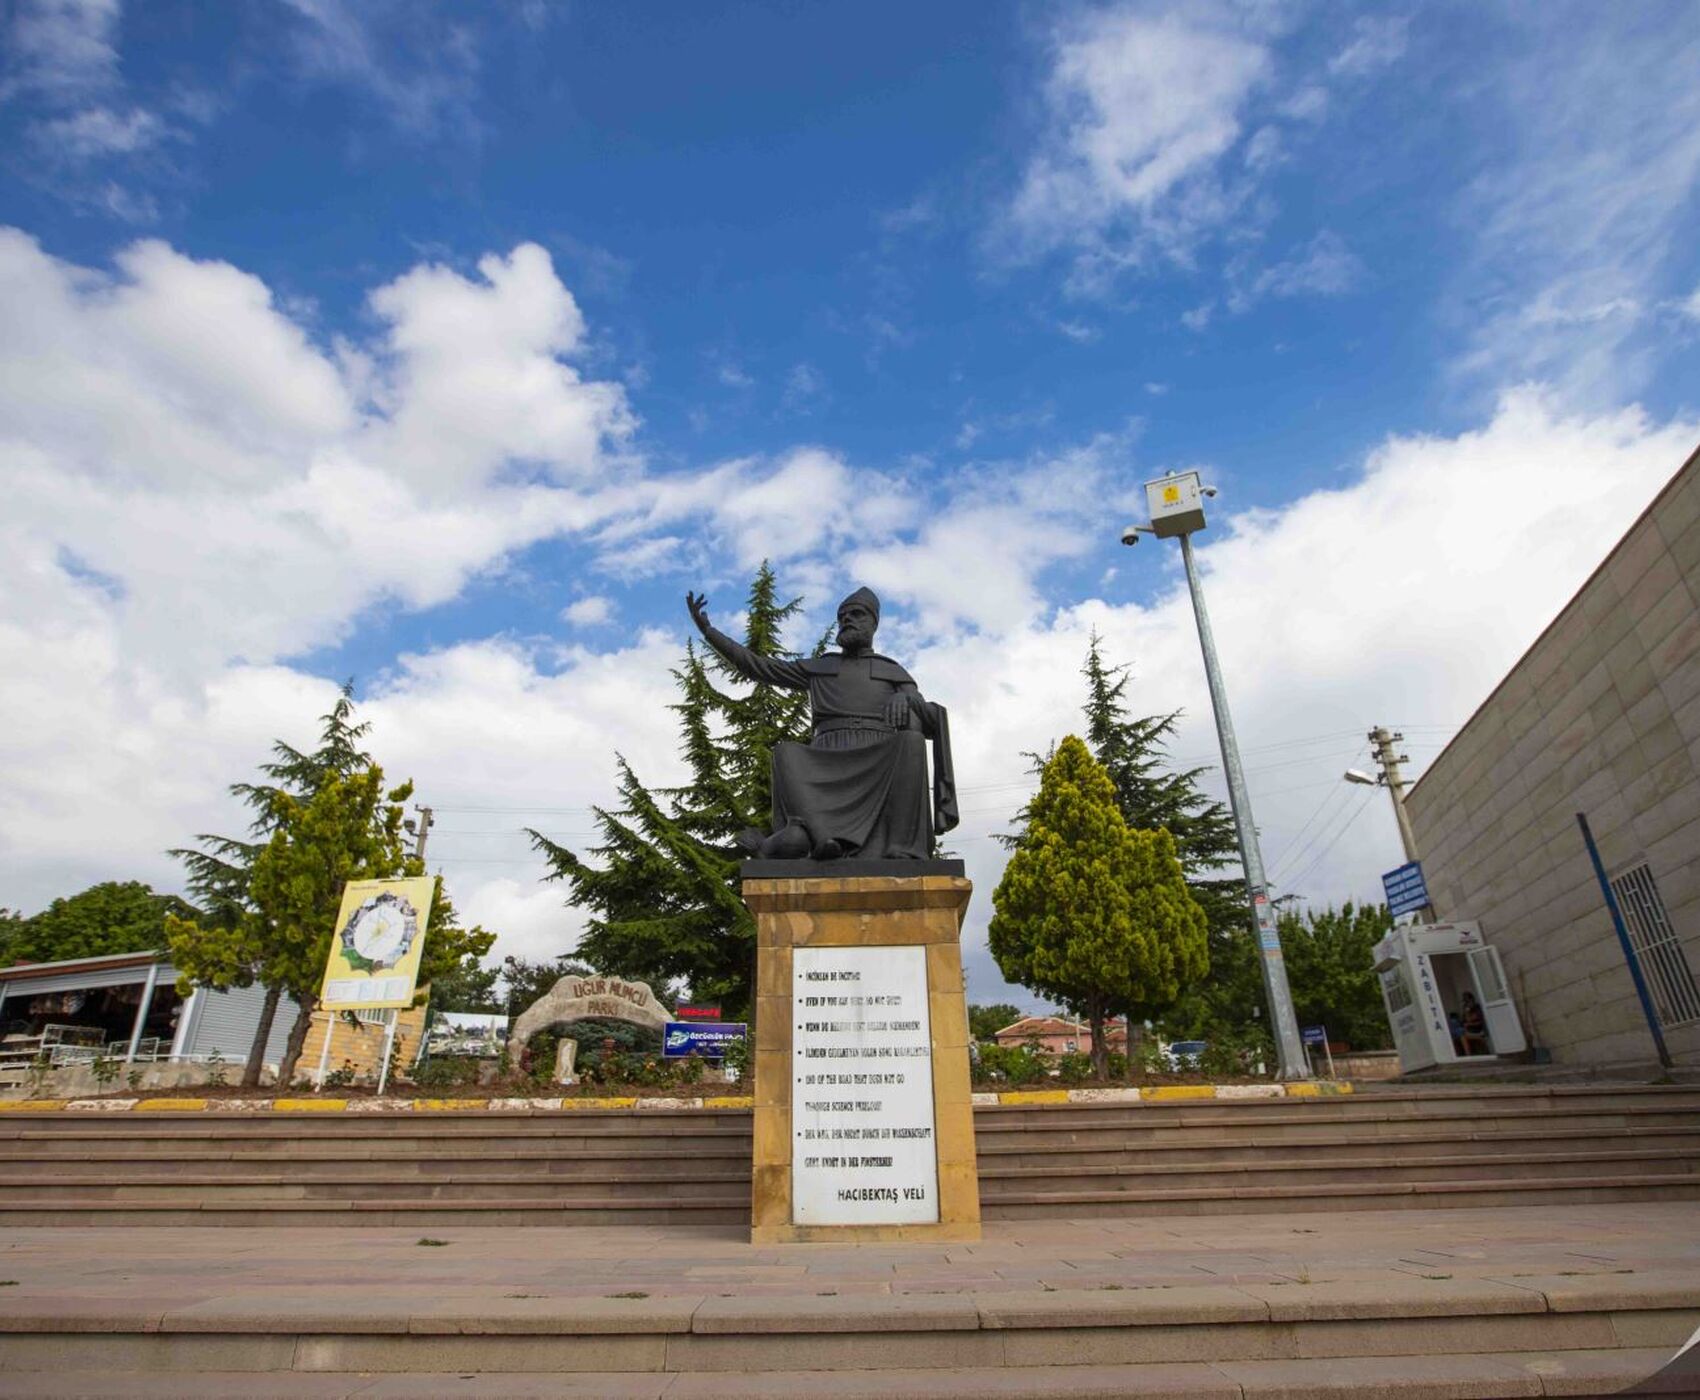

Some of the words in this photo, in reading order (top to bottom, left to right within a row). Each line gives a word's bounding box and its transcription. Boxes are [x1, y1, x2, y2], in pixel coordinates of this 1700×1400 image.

[573, 980, 606, 998] UĞUR
[608, 981, 648, 1007] MUMCU
[1417, 955, 1443, 1031] ZABITA
[837, 1187, 899, 1204] HACIBEKTAŞ
[903, 1184, 925, 1201] VELİ
